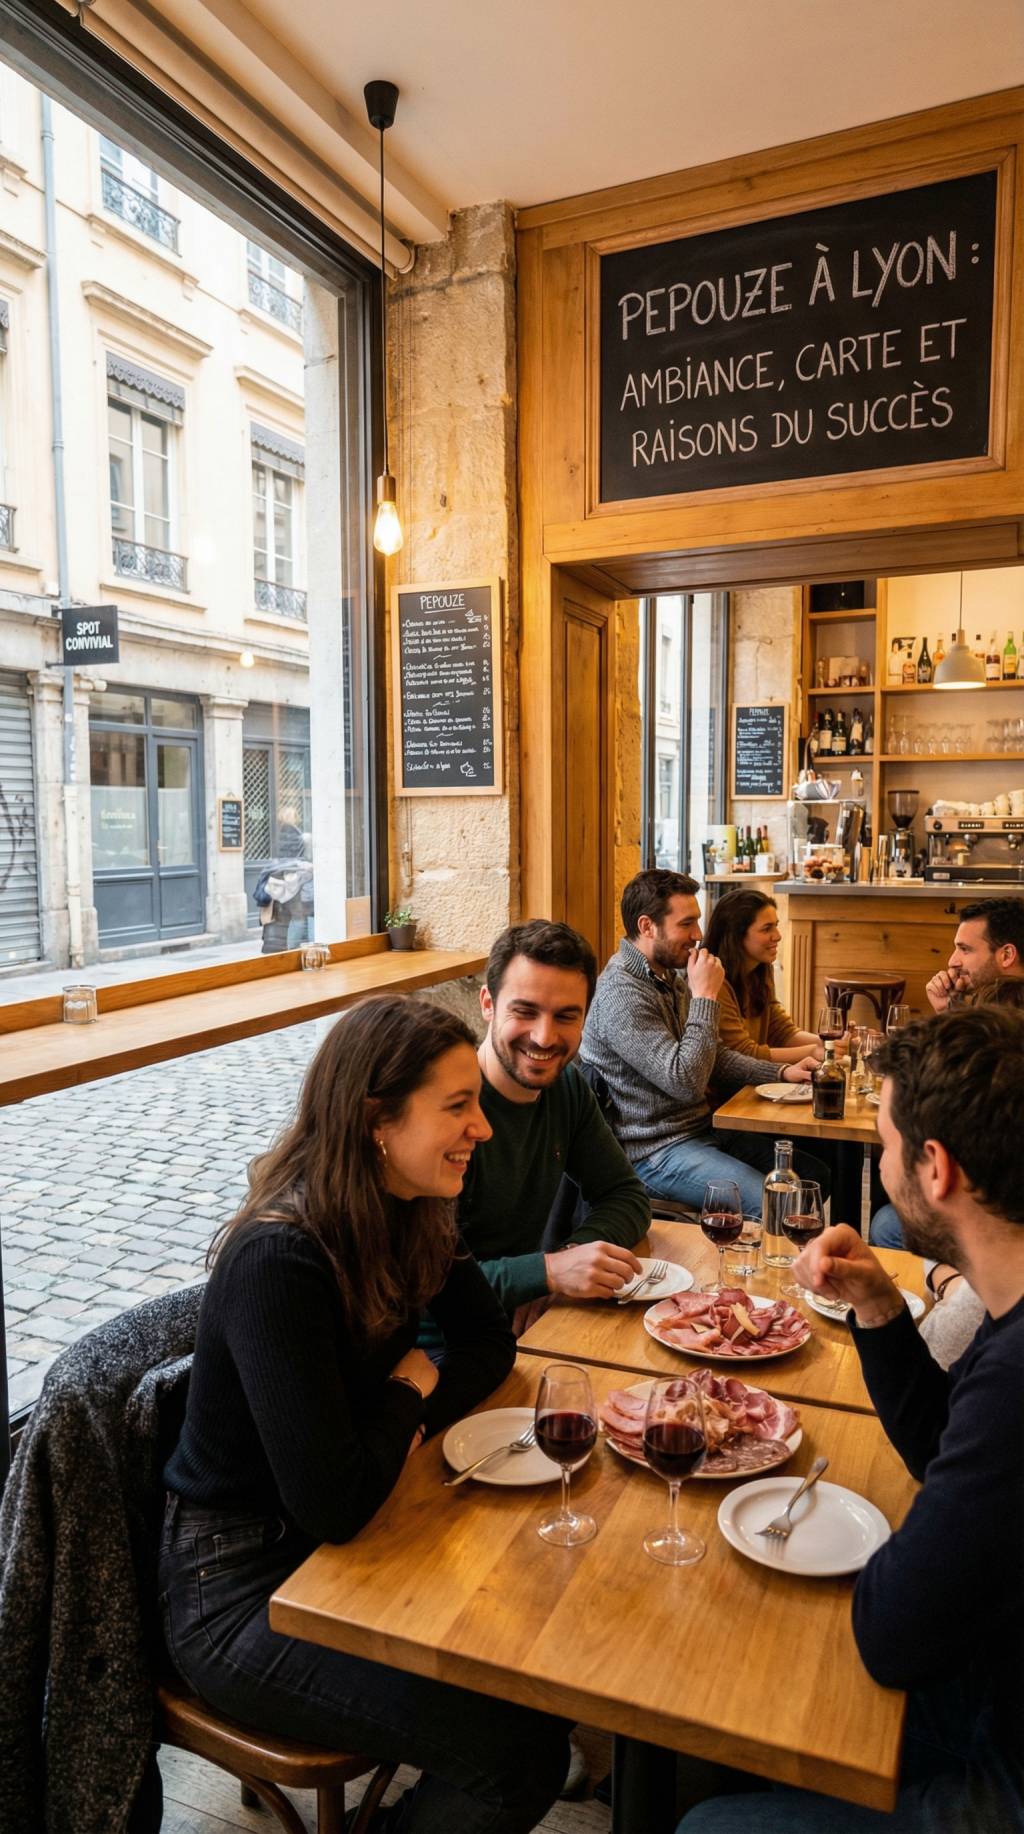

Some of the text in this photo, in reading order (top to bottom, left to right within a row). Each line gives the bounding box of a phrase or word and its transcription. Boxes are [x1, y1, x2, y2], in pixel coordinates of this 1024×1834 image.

[618, 262, 793, 341] PEPOUZE
[808, 242, 836, 306] À
[852, 230, 957, 308] LYON
[795, 329, 902, 381] CARTE
[919, 318, 968, 364] ET
[631, 380, 955, 468] RAISONS DU SUCCÈS
[420, 593, 465, 610] PEPOUZE
[65, 635, 114, 650] CONVIVIAL
[76, 620, 101, 635] SPOT
